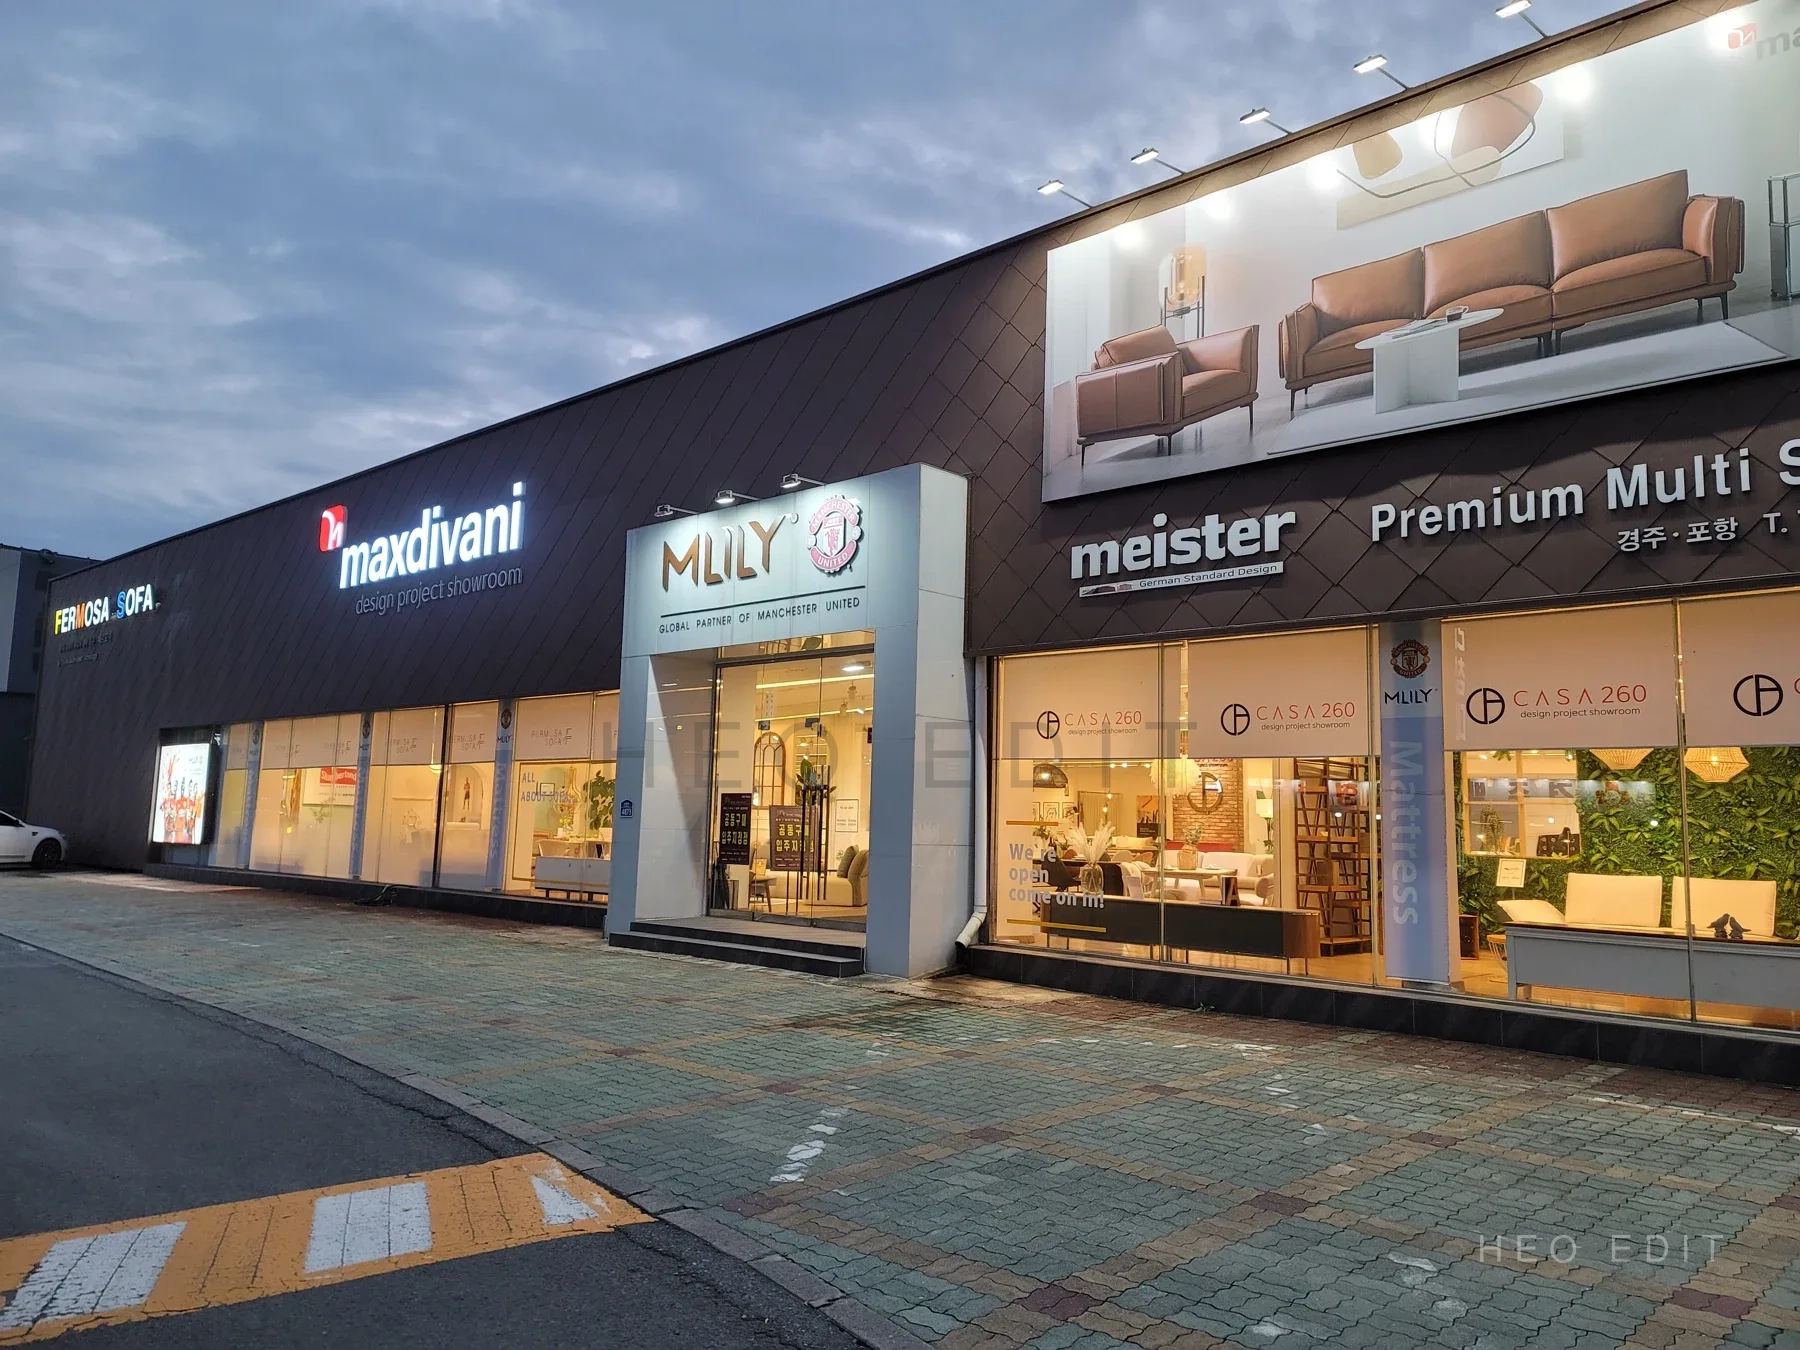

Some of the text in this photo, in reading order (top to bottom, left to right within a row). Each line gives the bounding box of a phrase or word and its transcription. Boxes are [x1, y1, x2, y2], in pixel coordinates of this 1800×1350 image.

[1371, 484, 1584, 542] Premium
[1607, 447, 1751, 510] Multi
[339, 481, 525, 589] maxdivani
[1071, 511, 1296, 579] meister
[818, 552, 848, 568] UNITED
[1140, 564, 1277, 587] German Standard Design
[356, 567, 523, 616] design project showroom
[54, 583, 153, 635] FERMOSA SOFA
[659, 597, 860, 634] GLOBAL PARTNER OF MANCHESTER UNITED
[1384, 688, 1433, 705] MLILY
[1513, 684, 1647, 707] CASA 260
[1064, 710, 1142, 726] CASA 260
[1256, 702, 1355, 720] CASA 260
[1520, 707, 1641, 720] design project showroom
[1068, 727, 1138, 736] design project showroom
[1261, 721, 1351, 732] design project showroom
[521, 771, 536, 783] ALL
[1389, 741, 1424, 925] Mattress
[1009, 868, 1049, 885] open
[1008, 888, 1105, 909] come on in!
